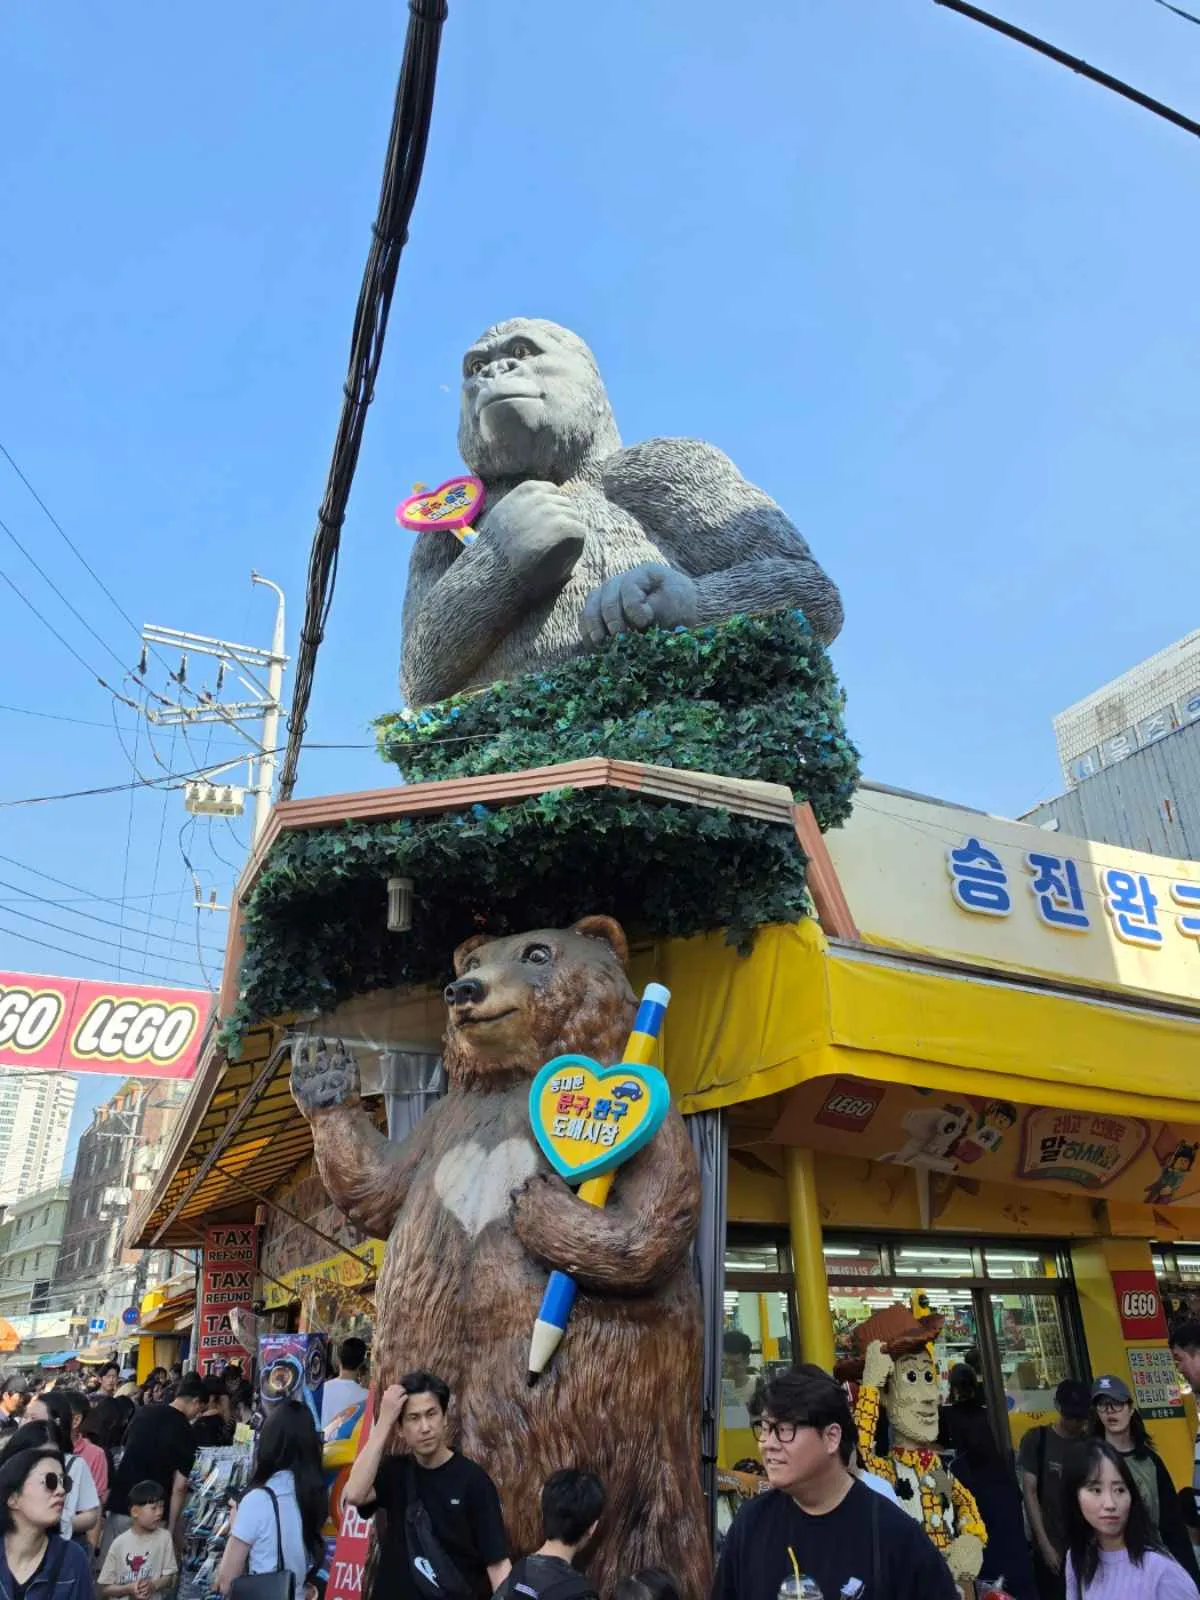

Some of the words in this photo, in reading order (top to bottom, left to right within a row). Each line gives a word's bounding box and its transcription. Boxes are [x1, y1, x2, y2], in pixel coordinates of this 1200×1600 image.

[0, 990, 61, 1049] GO
[74, 999, 195, 1060] LEGO
[827, 1094, 874, 1118] LEGO
[551, 1115, 619, 1146] 도매시장
[212, 1230, 252, 1246] TAX
[208, 1250, 253, 1261] REFUND
[209, 1272, 250, 1289] TAX
[206, 1291, 251, 1304] REFUND
[1124, 1294, 1156, 1316] LEGO
[334, 1562, 364, 1592] TAX
